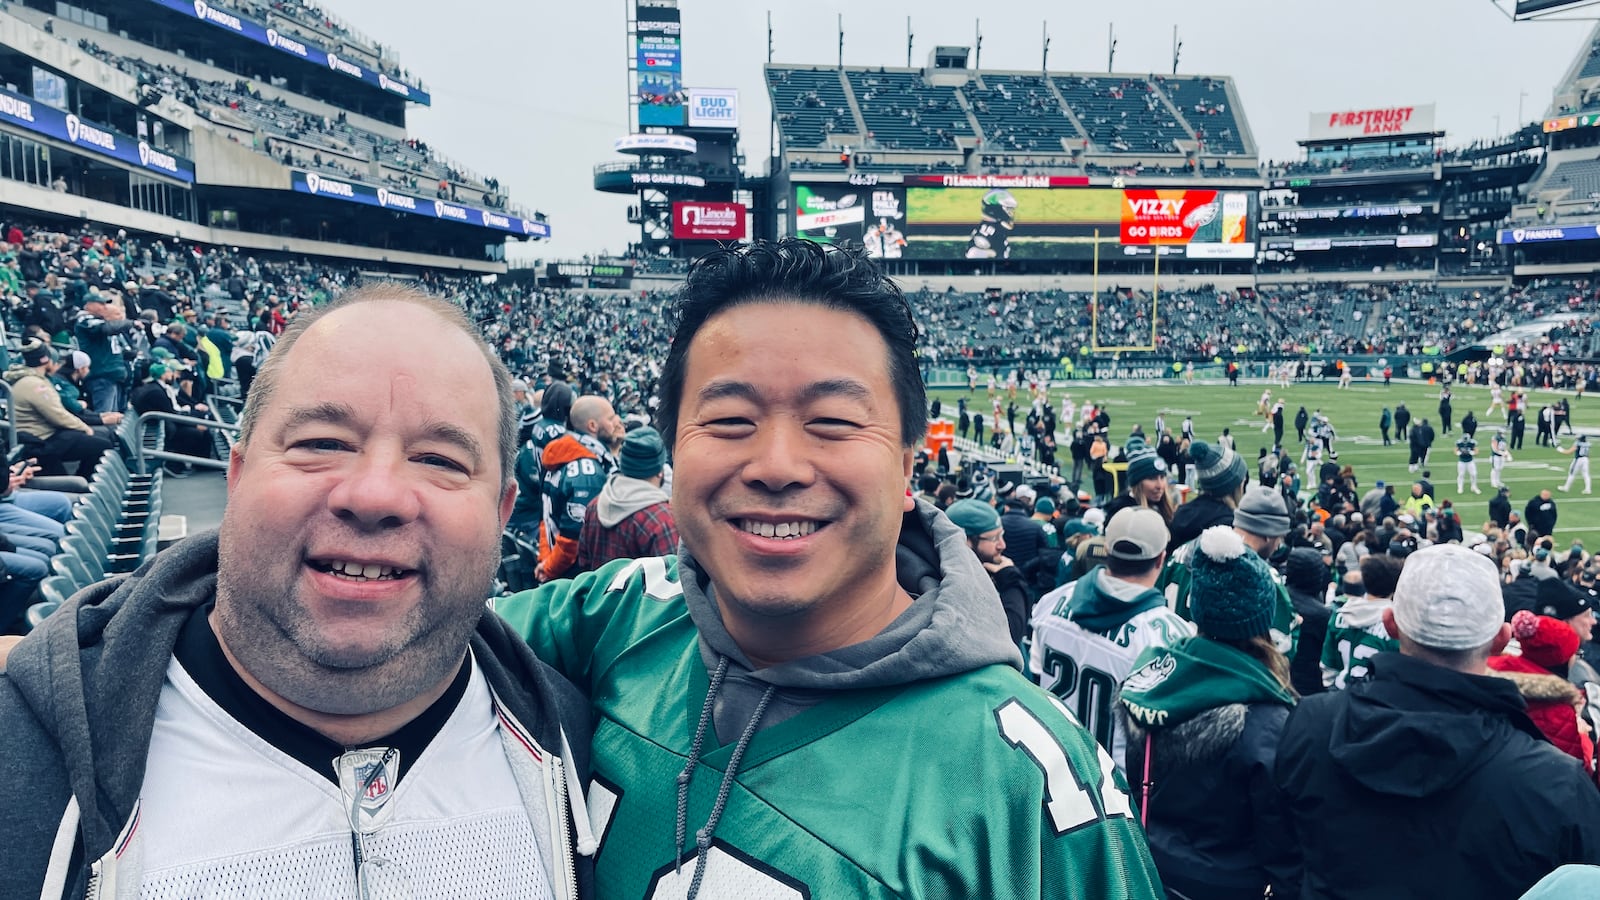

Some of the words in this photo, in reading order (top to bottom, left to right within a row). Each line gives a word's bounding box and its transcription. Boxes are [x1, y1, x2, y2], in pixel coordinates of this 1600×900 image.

[206, 7, 243, 31] FANDUEL
[277, 35, 308, 56] FANDUEL
[0, 94, 35, 122] NDUEL
[700, 98, 728, 107] BUD
[696, 108, 732, 118] LIGHT
[1363, 122, 1403, 134] BANK
[80, 122, 116, 150] FANDUEL
[149, 150, 178, 172] FANDUEL
[631, 173, 650, 183] THIS
[652, 174, 675, 184] GAME
[850, 174, 878, 185] 46:37
[954, 176, 986, 186] Lincoln
[987, 176, 1026, 186] Financial
[1027, 176, 1050, 187] Field
[319, 178, 354, 198] FANDUEL
[387, 192, 416, 210] FANDUEL
[1128, 198, 1186, 216] VIZZY
[444, 204, 467, 220] FANDUEL
[700, 206, 736, 219] Lincoln
[1128, 226, 1146, 237] GO
[1149, 226, 1182, 237] BRDS
[1526, 230, 1565, 240] FANDUEL
[558, 264, 593, 276] UNIBET
[1042, 646, 1116, 756] 20
